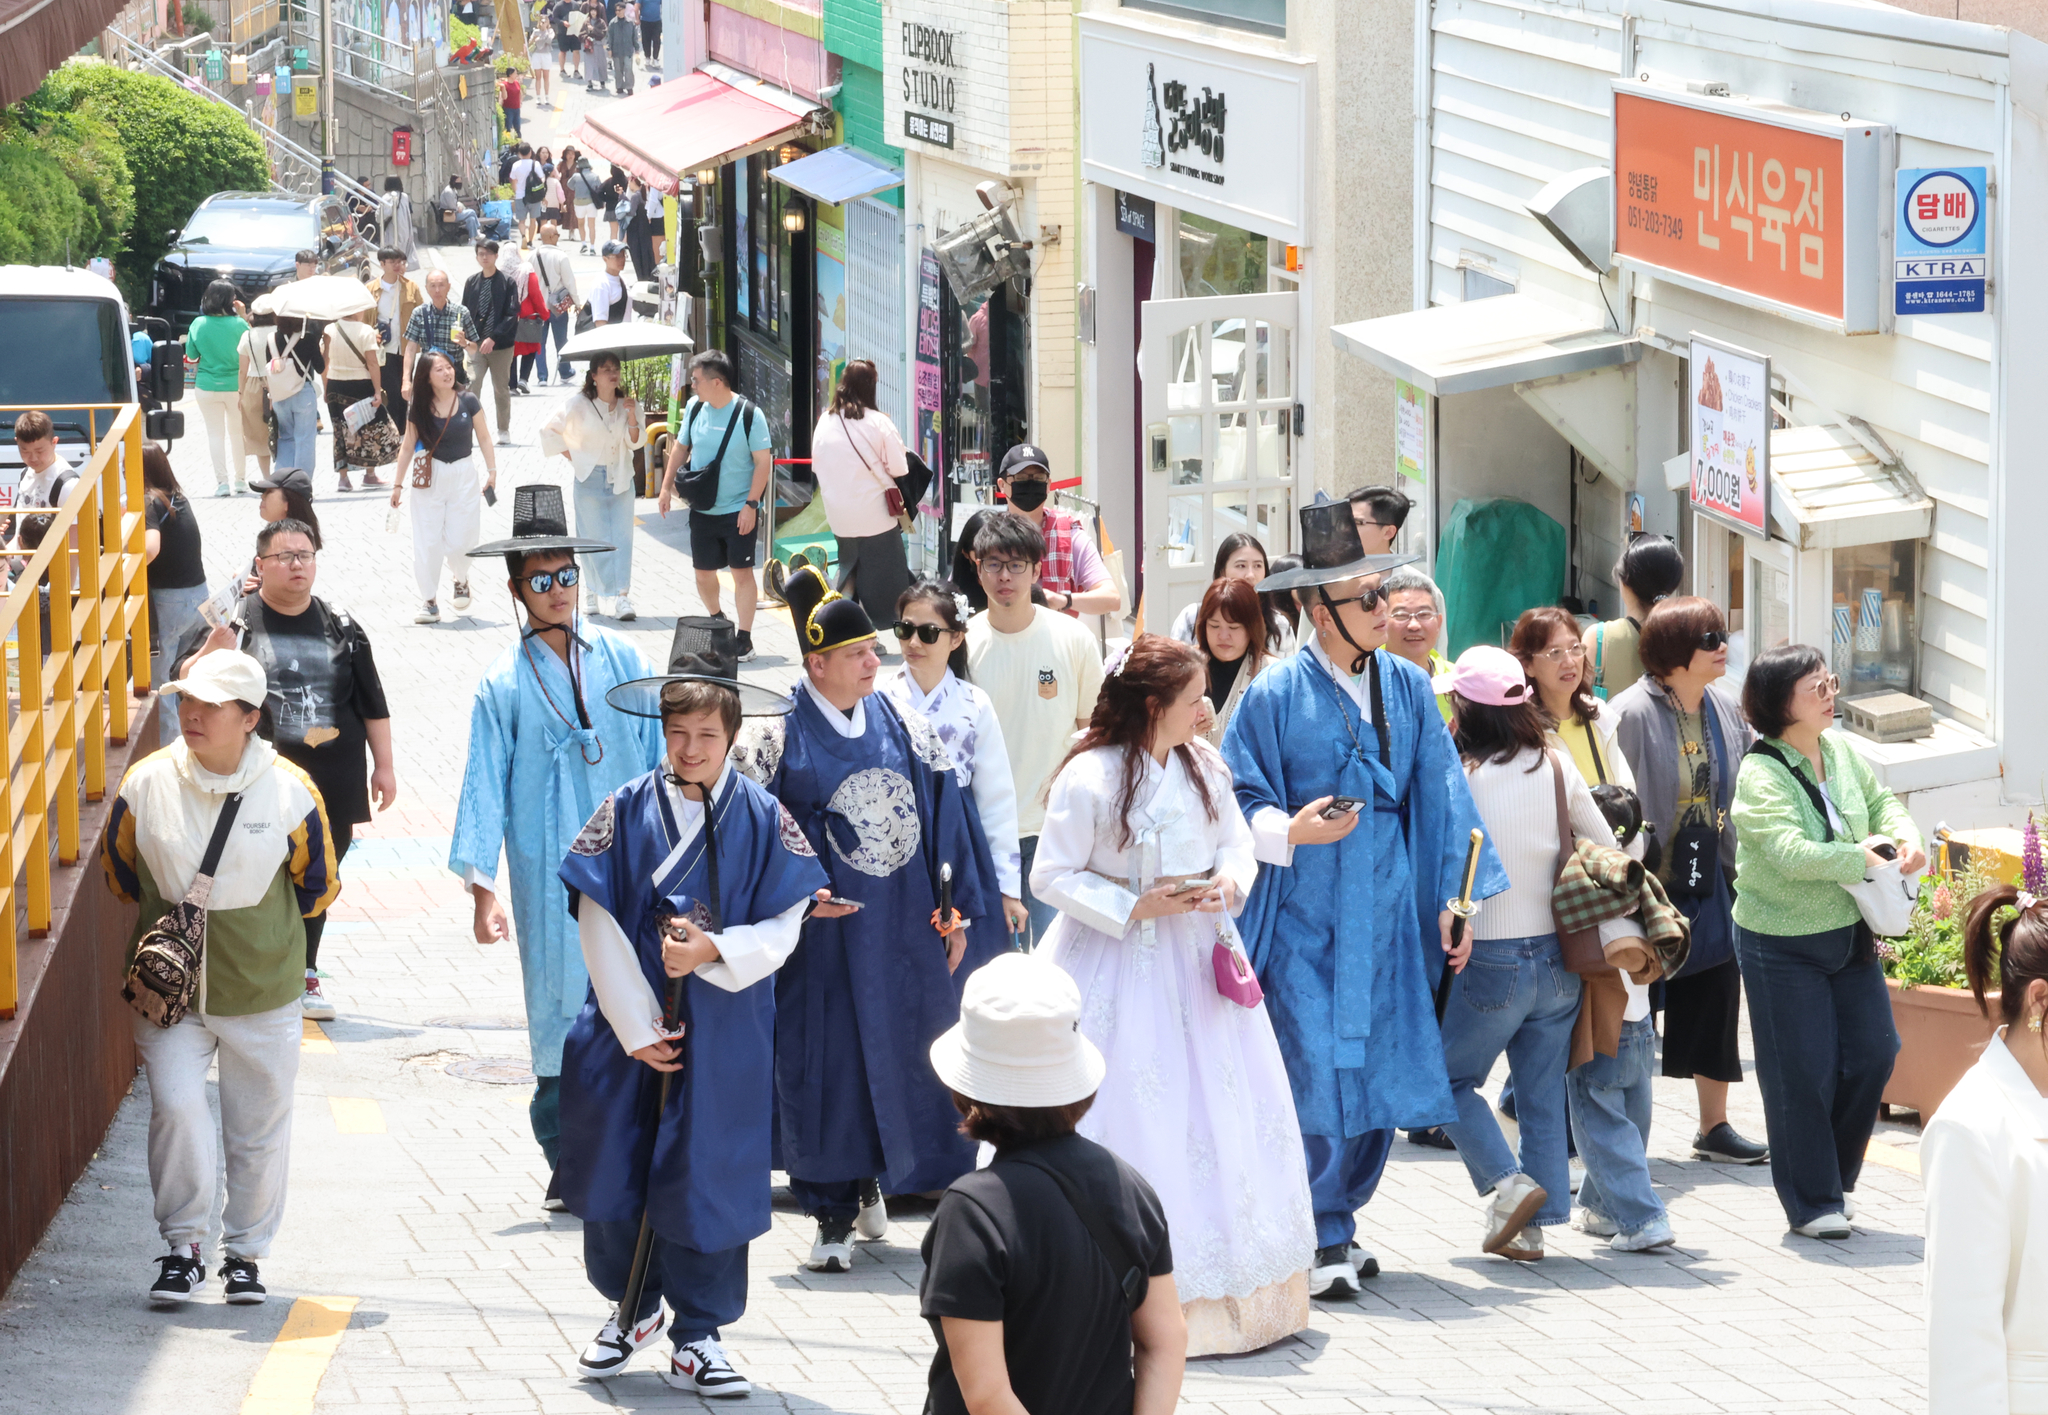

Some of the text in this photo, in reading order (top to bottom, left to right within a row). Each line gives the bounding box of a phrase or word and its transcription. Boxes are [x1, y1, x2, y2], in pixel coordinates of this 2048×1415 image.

[902, 21, 954, 67] FLIPBOOK
[903, 67, 954, 113] STUDIO
[909, 116, 928, 138] 움직이는
[1200, 170, 1225, 186] WORKSHOP
[1628, 171, 1658, 203] 양념통닭
[1693, 143, 1824, 280] 민식육점
[1917, 192, 1966, 220] 담배
[1132, 211, 1146, 230] SPACE
[1628, 205, 1683, 241] 051-203-7349
[1906, 261, 1974, 277] KTRA
[1905, 297, 1976, 305] www.ktranews.co.kr
[1936, 290, 1976, 299] 1644-1785
[1695, 458, 1741, 509] 7,000원
